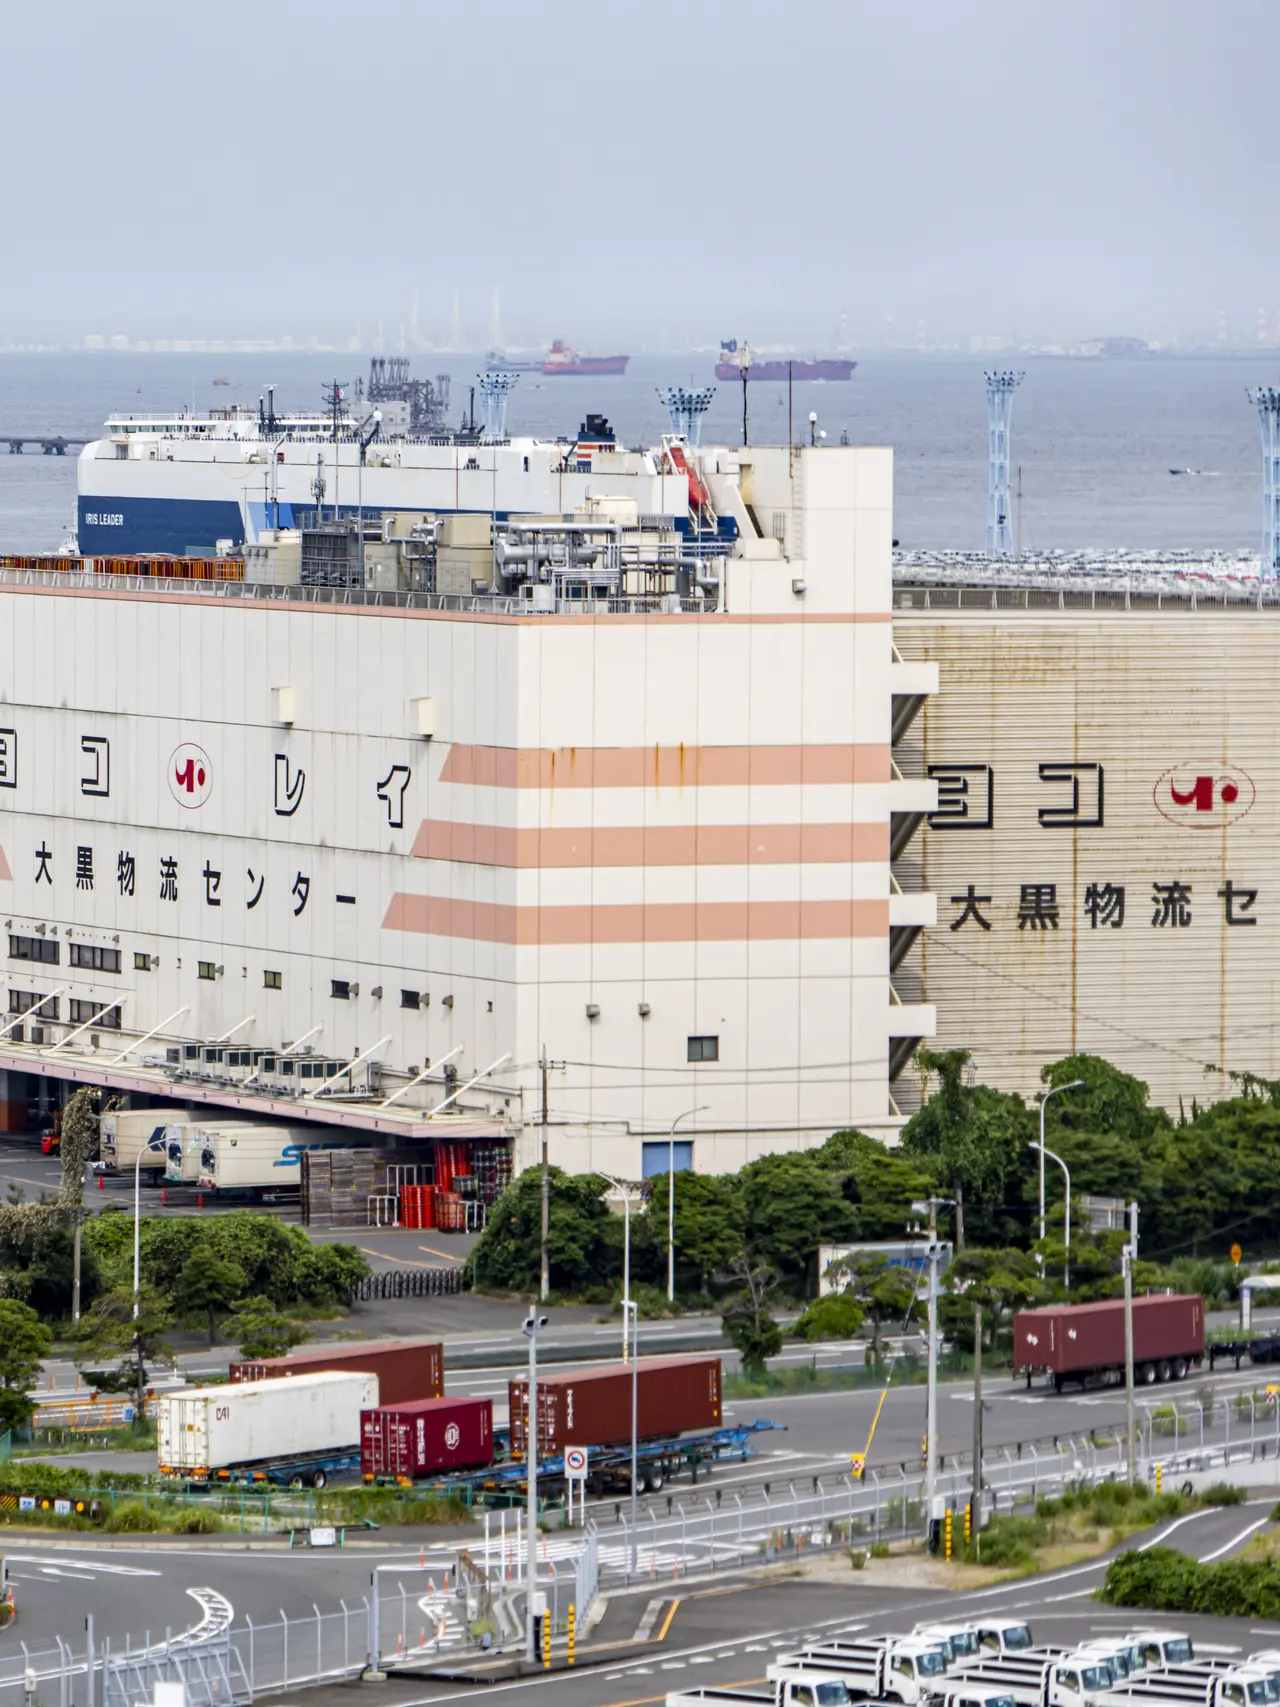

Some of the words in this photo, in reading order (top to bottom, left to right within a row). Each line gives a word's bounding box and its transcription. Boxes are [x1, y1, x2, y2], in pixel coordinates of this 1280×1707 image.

[85, 513, 98, 525] IRIS
[99, 513, 124, 526] LEADER
[35, 840, 356, 917] 大黒物流センター
[949, 880, 1258, 932] 大黒物流セ
[216, 1406, 230, 1421] CAI
